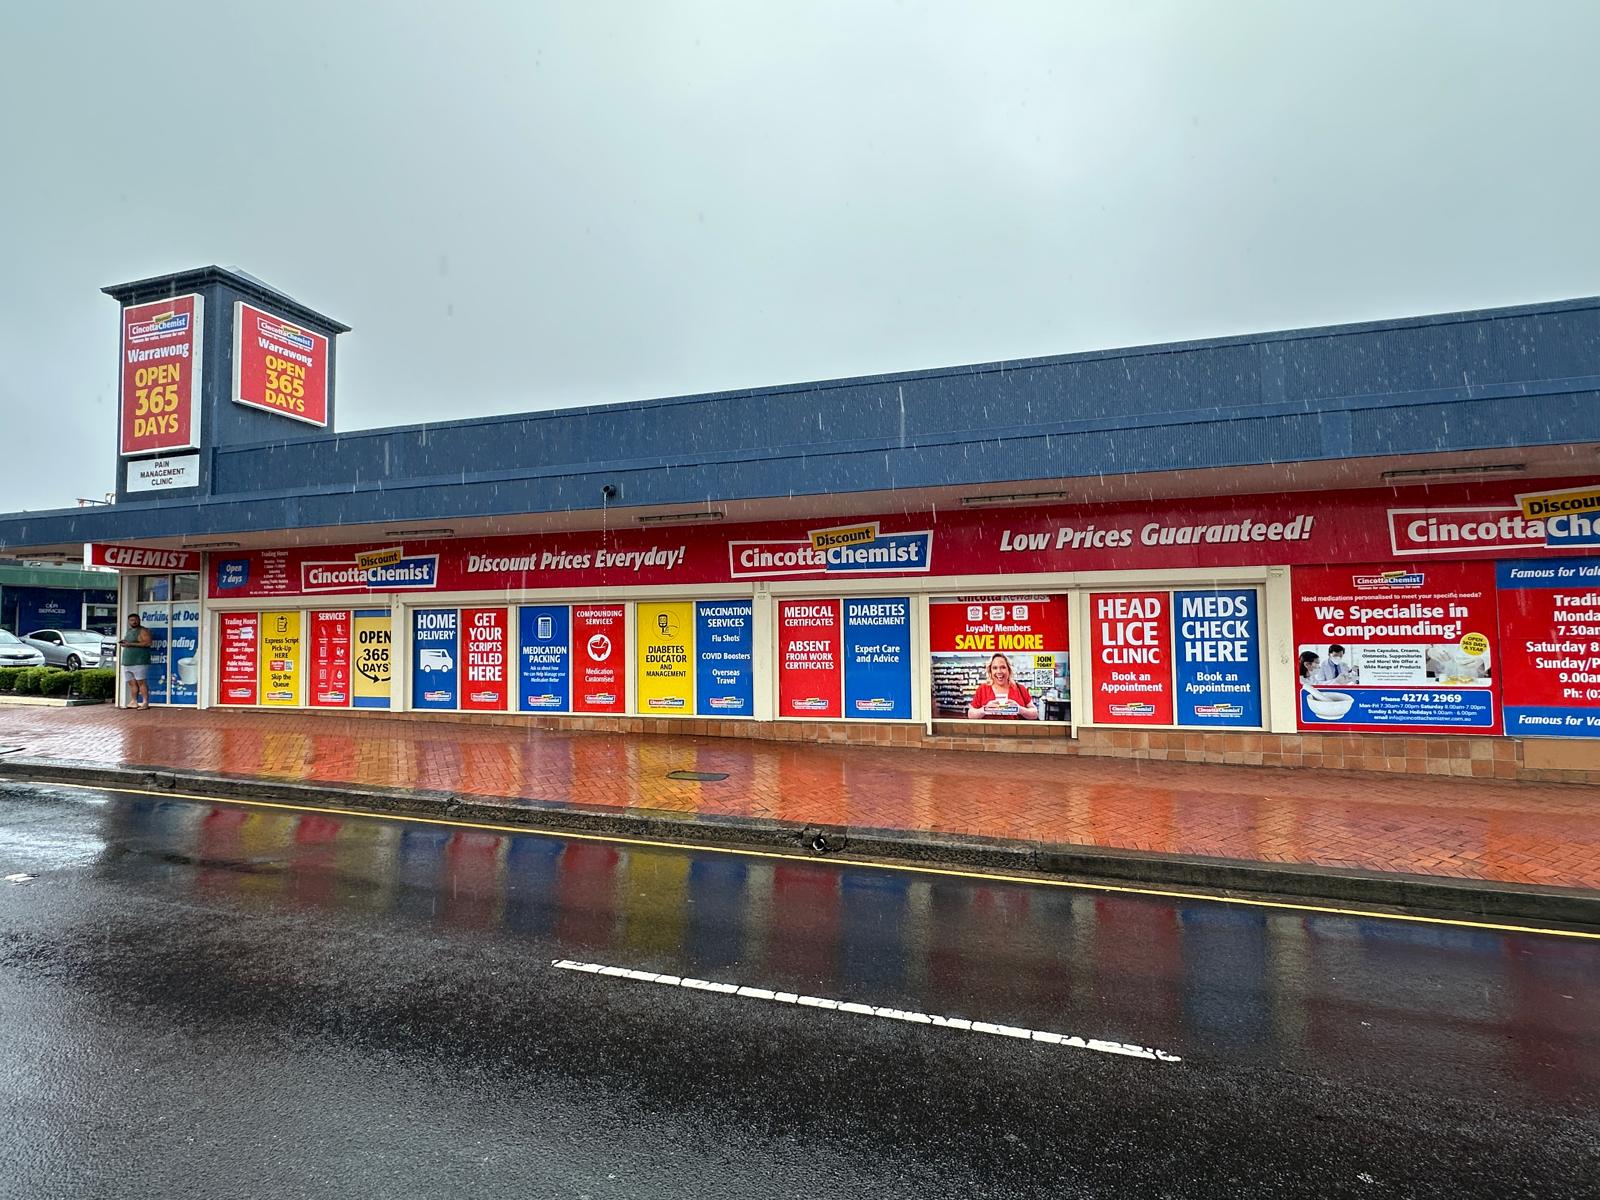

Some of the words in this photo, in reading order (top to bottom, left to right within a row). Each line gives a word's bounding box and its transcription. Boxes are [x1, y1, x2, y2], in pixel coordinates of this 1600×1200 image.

[127, 342, 190, 363] Warrawong
[258, 336, 313, 367] Warrawong
[265, 354, 306, 380] OPEN
[135, 363, 180, 388] OPEN
[265, 368, 305, 398] 365
[135, 384, 179, 416] 365
[265, 388, 305, 412] DAYS
[134, 414, 179, 438] DAYS
[154, 460, 170, 468] PAIN
[140, 467, 184, 478] MANAGEMENT
[151, 477, 173, 486] CLINIC
[816, 528, 871, 548] Discount
[1000, 529, 1049, 551] Low
[1056, 525, 1132, 549] Prices
[1140, 515, 1315, 546] Guaranteed!
[104, 547, 189, 568] CHEMIST
[361, 552, 398, 567] Discount
[467, 553, 536, 573] Discount
[539, 550, 591, 569] Prices
[595, 545, 686, 571] Everyday!
[740, 542, 919, 567] CincottaChemist
[226, 564, 242, 573] Open
[309, 563, 430, 584] CincottaChemist
[1510, 568, 1554, 578] Famous
[1558, 567, 1575, 577] for
[223, 575, 228, 583] 7
[228, 575, 243, 584] days
[1357, 576, 1420, 584] CincottaChemist
[1354, 594, 1393, 602] personalised
[700, 606, 752, 616] VACCINATION
[784, 605, 834, 618] MEDICAL
[849, 603, 905, 617] DIABETES
[1098, 598, 1161, 620] HEAD
[1182, 596, 1248, 618] MEDS
[142, 611, 168, 624] Parking
[172, 611, 181, 621] at
[318, 612, 346, 621] SERVICES
[1314, 606, 1345, 620] We
[1349, 603, 1444, 623] Specialise
[1449, 603, 1468, 617] in
[225, 618, 243, 626] Trading
[417, 613, 456, 629] HOME
[474, 612, 497, 627] GET
[707, 618, 745, 628] SERVICES
[785, 618, 834, 627] CERTIFICATES
[848, 616, 905, 626] MANAGEMENT
[966, 623, 993, 633] Loyalty
[994, 623, 1031, 632] Members
[1101, 621, 1159, 646] LICE
[1181, 620, 1250, 639] CHECK
[1322, 621, 1461, 640] Compounding!
[360, 630, 391, 644] OPEN
[469, 627, 502, 641] YOUR
[712, 634, 721, 642] Flu
[722, 634, 740, 642] Shots
[265, 637, 284, 645] Express
[285, 637, 300, 645] Script
[788, 640, 830, 652] ABSENT
[955, 634, 995, 650] SAVE
[999, 634, 1044, 650] MORE
[272, 645, 292, 653] Pick-Up
[469, 642, 502, 652] SCRIPTS
[522, 646, 567, 655] MEDICATION
[648, 645, 685, 653] DIABETES
[855, 644, 880, 653] Expert
[881, 644, 900, 653] Care
[1185, 641, 1249, 662] HERE
[1526, 641, 1586, 655] Saturday
[363, 648, 389, 662] 365
[469, 652, 503, 665] FILLED
[529, 654, 561, 663] PACKING
[645, 654, 687, 663] EDUCATOR
[702, 652, 721, 660] COVID
[723, 652, 751, 660] Boosters
[786, 652, 808, 661] FROM
[808, 652, 833, 661] WORK
[856, 654, 871, 663] and
[873, 653, 900, 663] Advice
[1036, 655, 1052, 663] JOIN
[1101, 647, 1160, 664] CLINIC
[363, 663, 389, 673] DAYS
[785, 661, 834, 670] CERTIFICATES
[1536, 657, 1600, 671] Sunday/P
[469, 665, 503, 682] HERE
[585, 667, 614, 675] Medication
[712, 668, 740, 677] Overseas
[1111, 671, 1136, 681] Book
[1138, 673, 1150, 681] an
[1196, 671, 1222, 681] Book
[1225, 673, 1238, 681] an
[272, 673, 282, 681] Skip
[585, 675, 615, 683] Customised
[716, 676, 736, 685] Travel
[1101, 682, 1163, 693] Appointment
[1185, 682, 1251, 693] Appointment
[1563, 688, 1583, 698] Ph:
[1402, 694, 1430, 702] 4274
[1432, 694, 1462, 703] 2969
[1519, 715, 1562, 725] Famous
[1565, 716, 1583, 725] for
